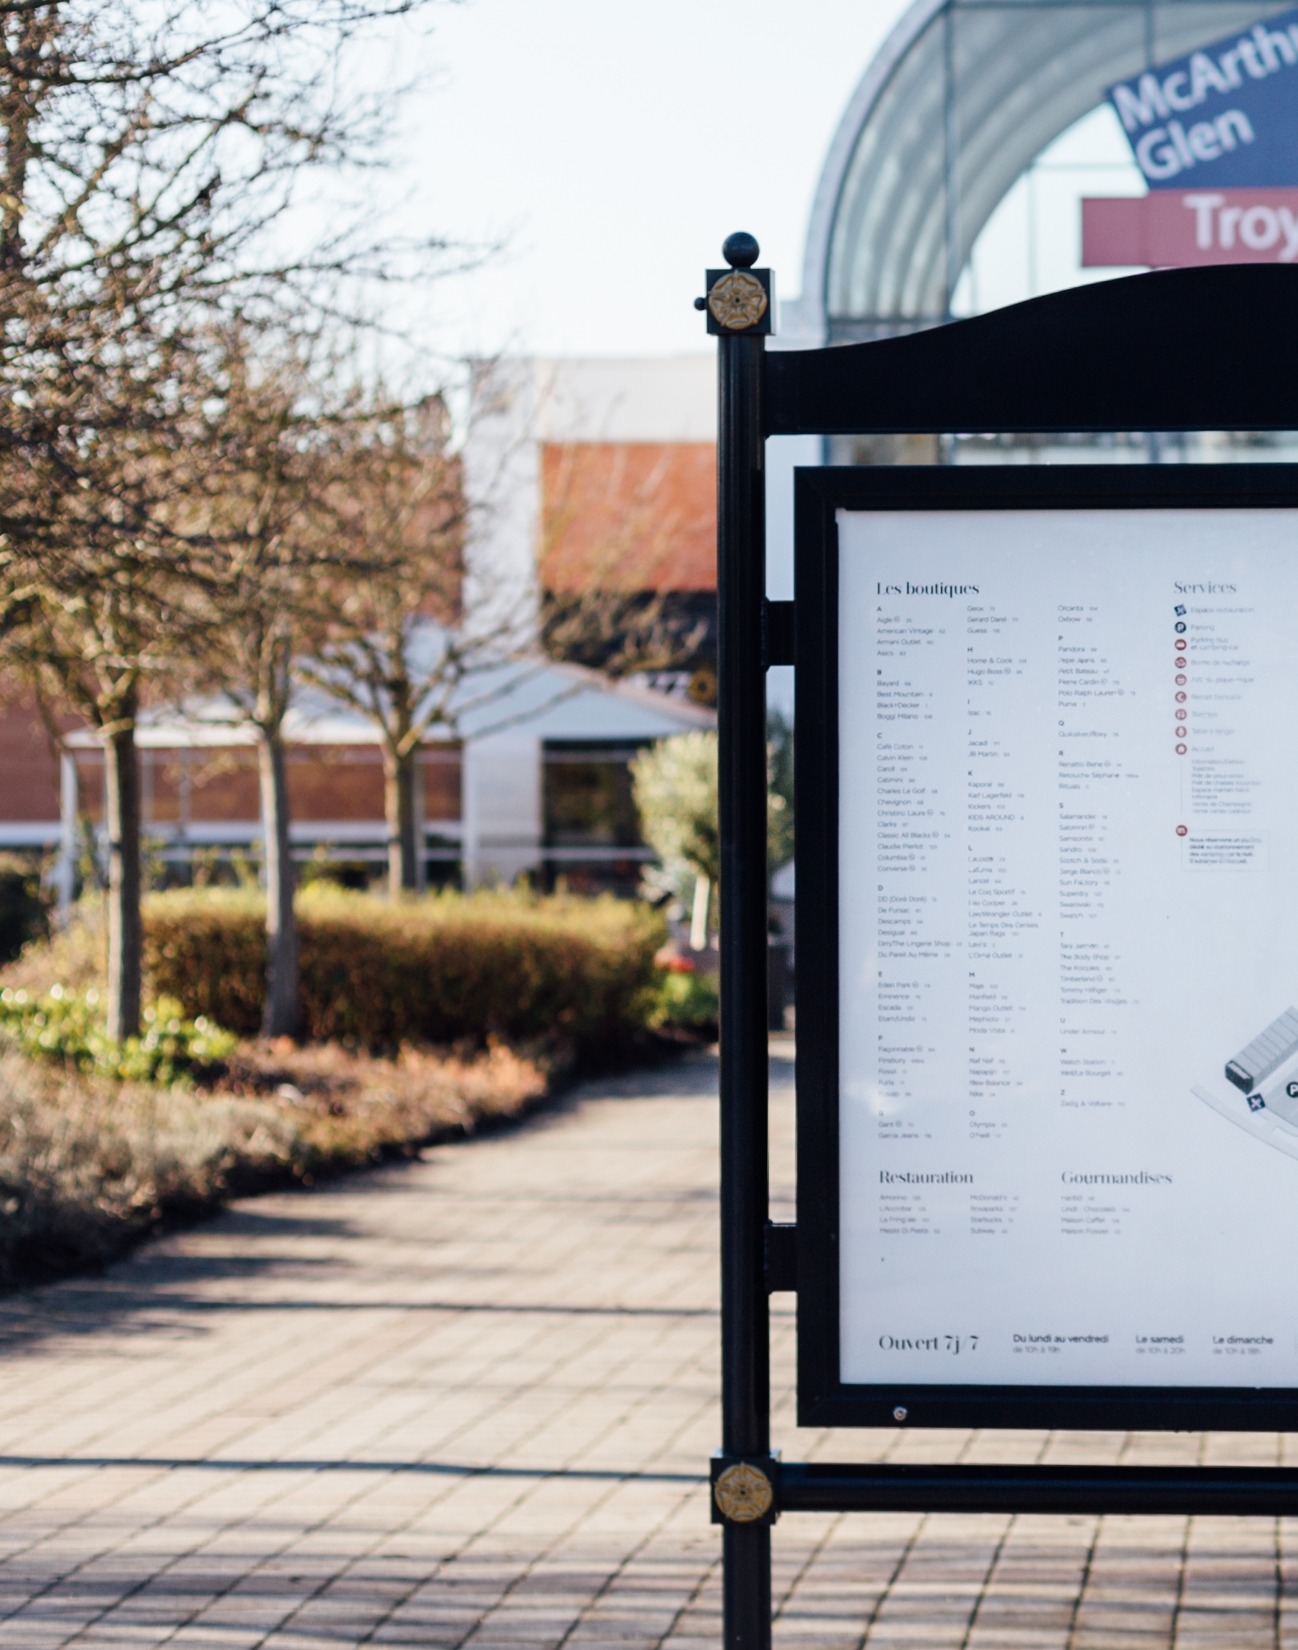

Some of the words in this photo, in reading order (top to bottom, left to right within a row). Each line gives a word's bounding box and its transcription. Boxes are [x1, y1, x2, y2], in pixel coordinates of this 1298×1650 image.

[1135, 108, 1255, 181] Glen
[877, 582, 901, 595] Les
[906, 581, 980, 598] boutiques
[1174, 581, 1237, 594] Services
[880, 1170, 973, 1184] Restauration
[1061, 1170, 1173, 1185] Gourmandises
[878, 1333, 939, 1351] Ouvert
[1013, 1334, 1027, 1343] Du
[1029, 1334, 1052, 1343] lundi
[1054, 1335, 1066, 1343] au
[1068, 1334, 1108, 1343] vendredi
[1136, 1335, 1147, 1344] Le
[1150, 1335, 1184, 1344] samedi
[1212, 1335, 1224, 1344] Le
[1227, 1335, 1274, 1345] dimanche
[1013, 1345, 1023, 1354] de
[1025, 1345, 1038, 1354] 10h
[1135, 1347, 1147, 1355] de
[1149, 1347, 1162, 1355] 10h
[1170, 1347, 1186, 1355] 20h
[1212, 1347, 1223, 1355] de
[1225, 1347, 1239, 1355] 10h
